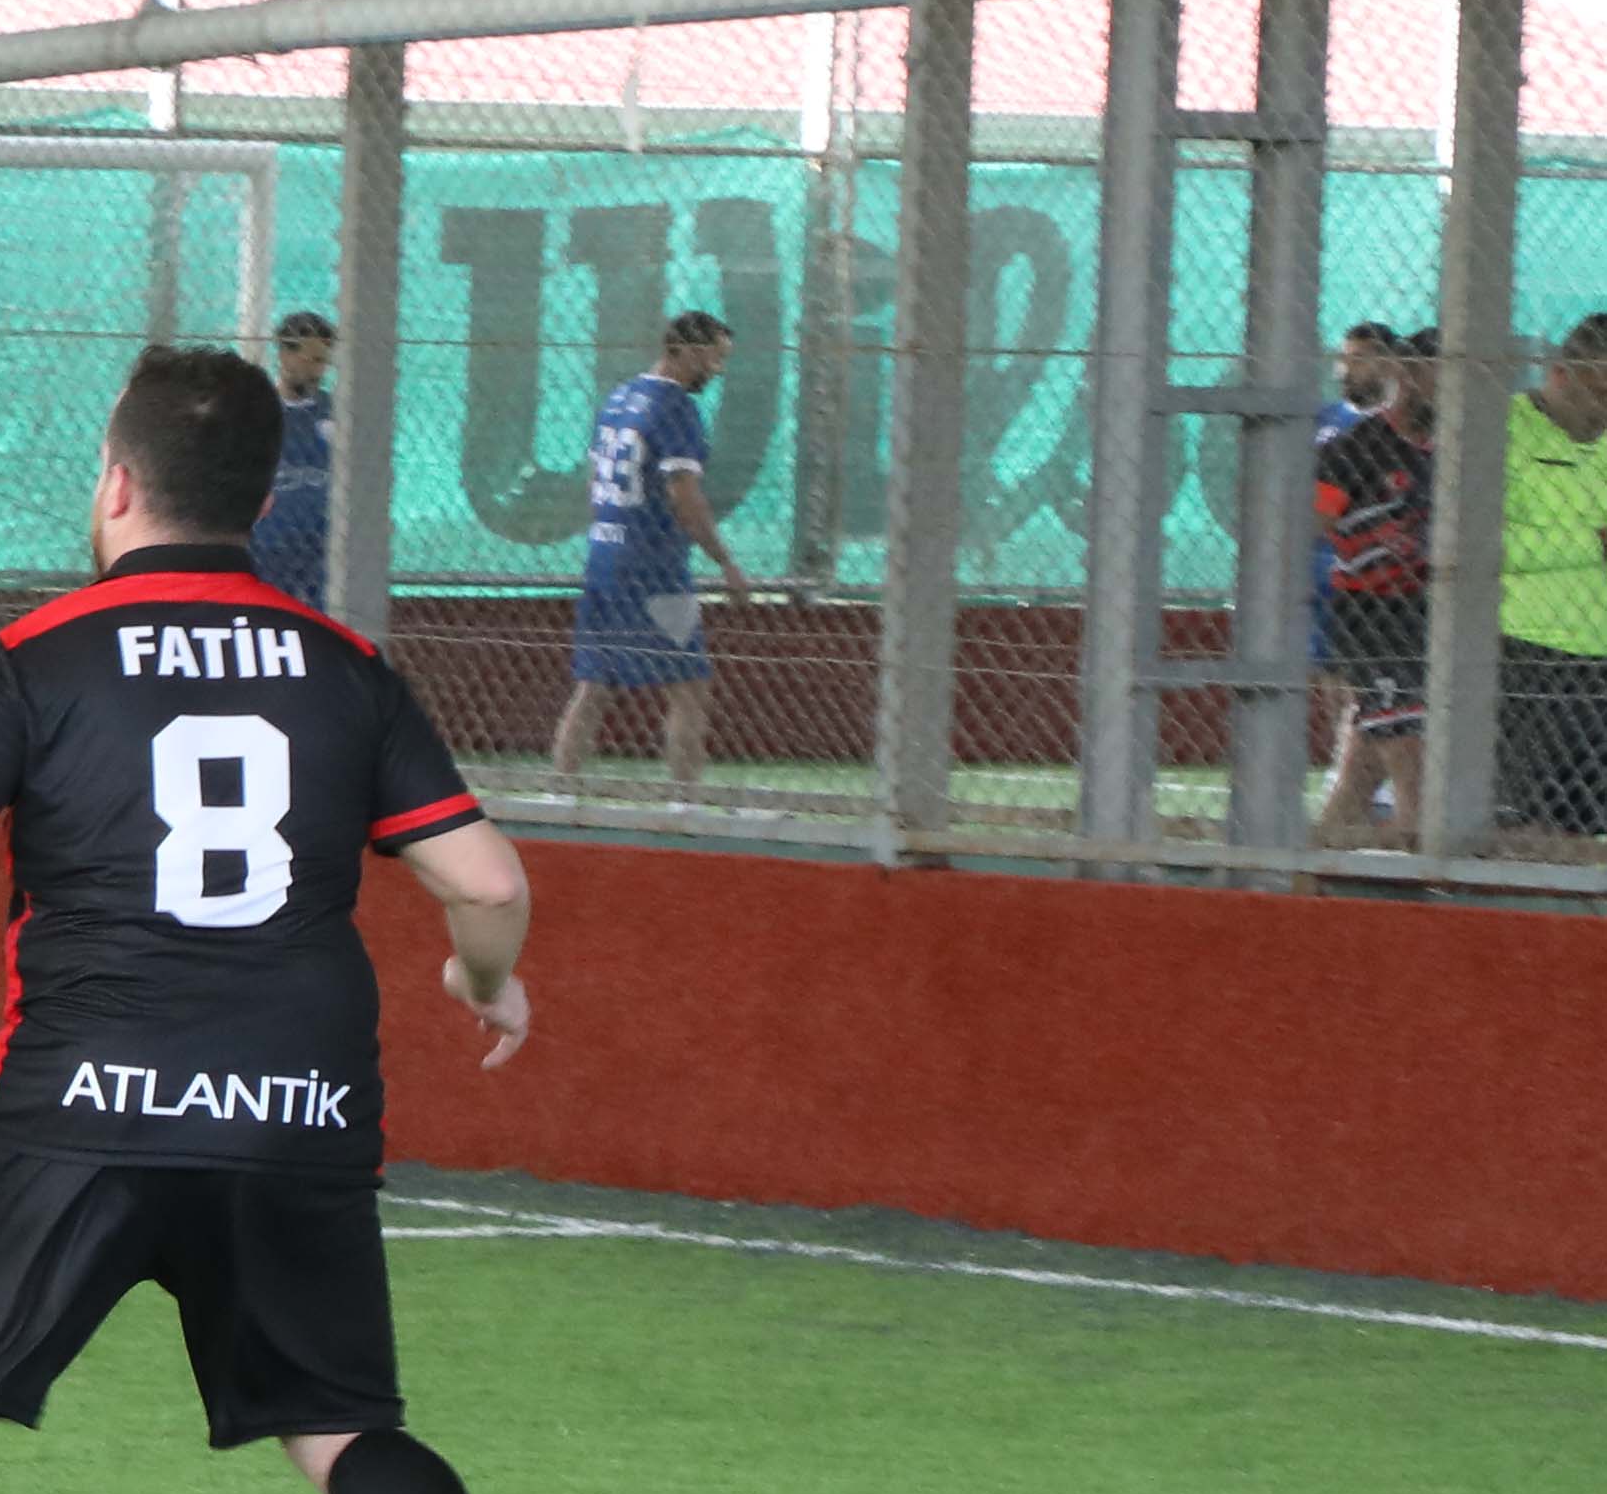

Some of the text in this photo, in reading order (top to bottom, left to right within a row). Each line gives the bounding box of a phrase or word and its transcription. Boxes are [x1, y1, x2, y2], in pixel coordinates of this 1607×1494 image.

[117, 615, 307, 679] FATİH
[152, 714, 293, 928] 8
[61, 1061, 351, 1128] ATLANTİK
